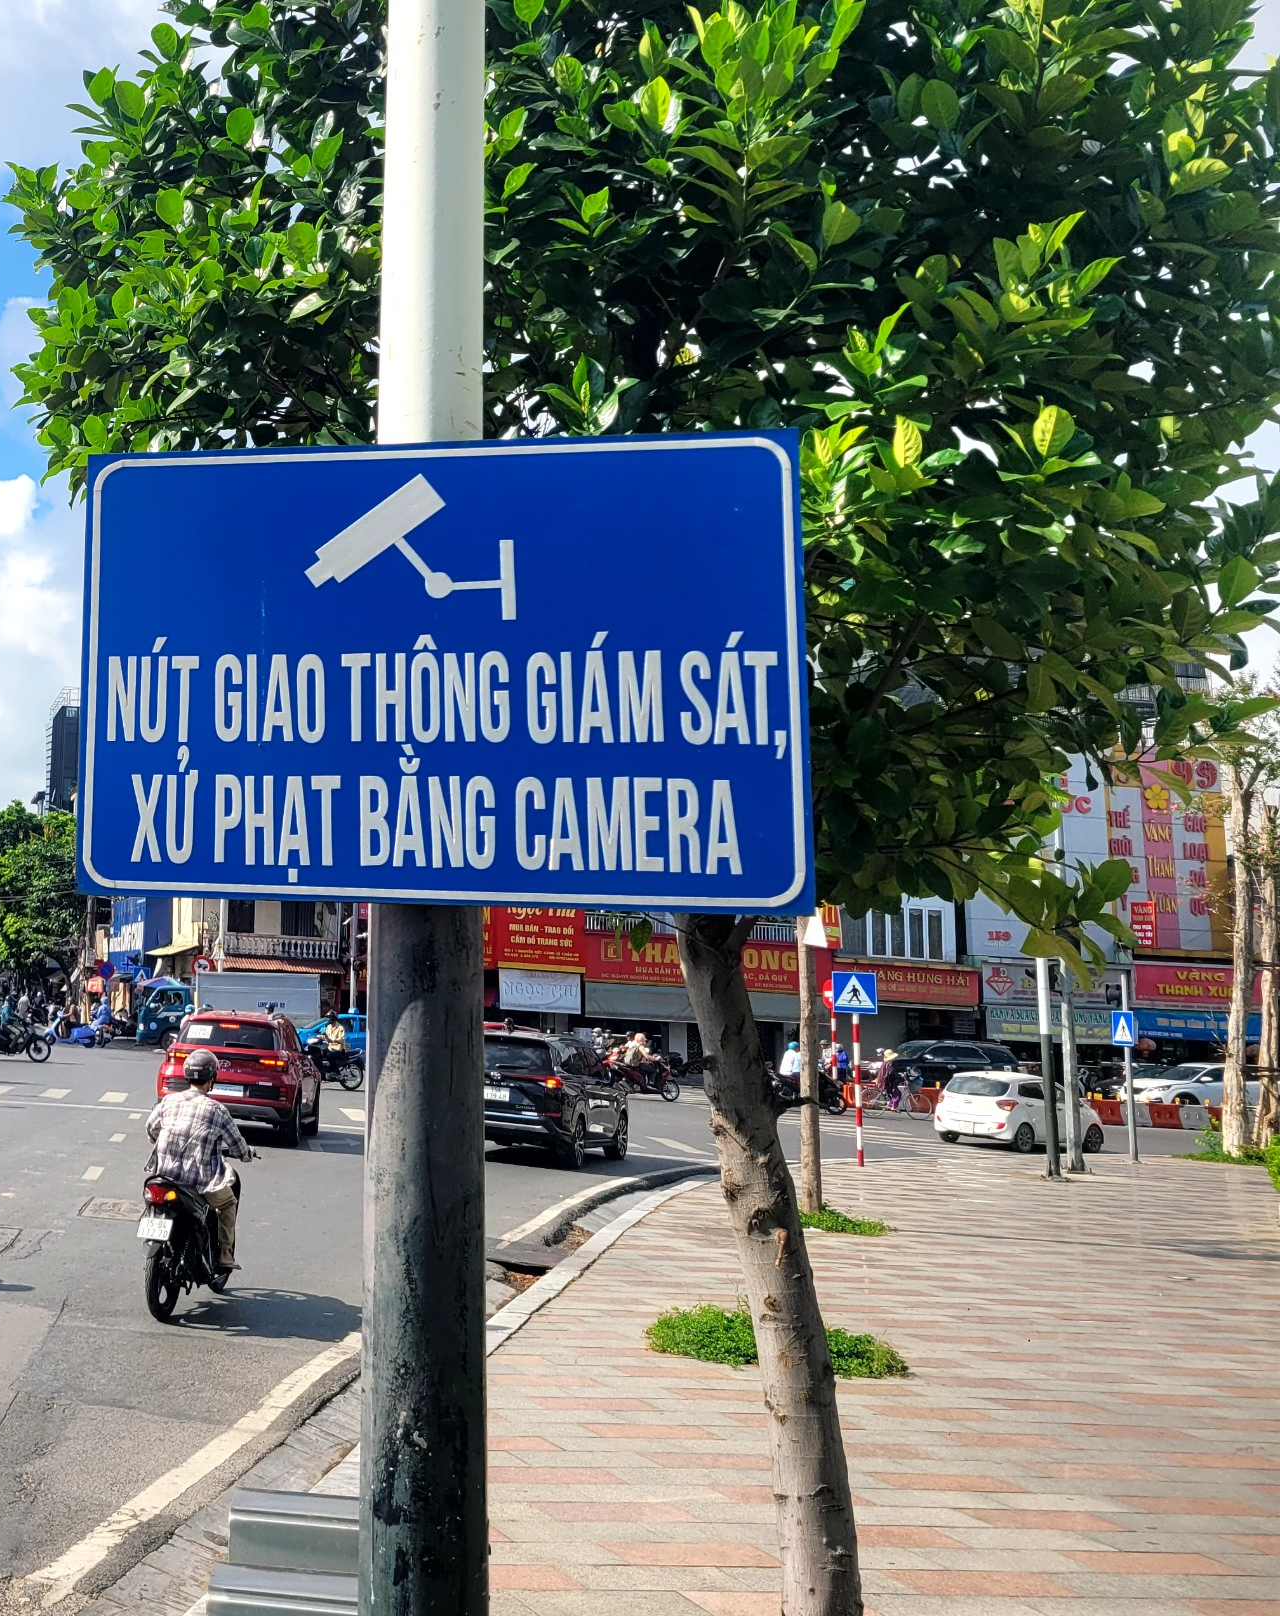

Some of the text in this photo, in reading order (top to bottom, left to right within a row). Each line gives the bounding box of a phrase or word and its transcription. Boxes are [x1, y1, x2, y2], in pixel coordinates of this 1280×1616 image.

[107, 631, 787, 759] NÚT GIAO THÔNG GIÁM SÁT,
[131, 744, 743, 883] XỬ PHẠT BẰNG CAMERA
[1109, 804, 1131, 829] THẾ
[509, 923, 524, 932] MUA
[525, 923, 539, 933] BÁN
[544, 926, 561, 934] TRAO
[537, 938, 558, 946] TRANG
[628, 940, 798, 972] THÀ ONG
[635, 965, 654, 974] MUA
[655, 966, 671, 975] BÁN
[1157, 983, 1234, 998] THANH XUÂ
